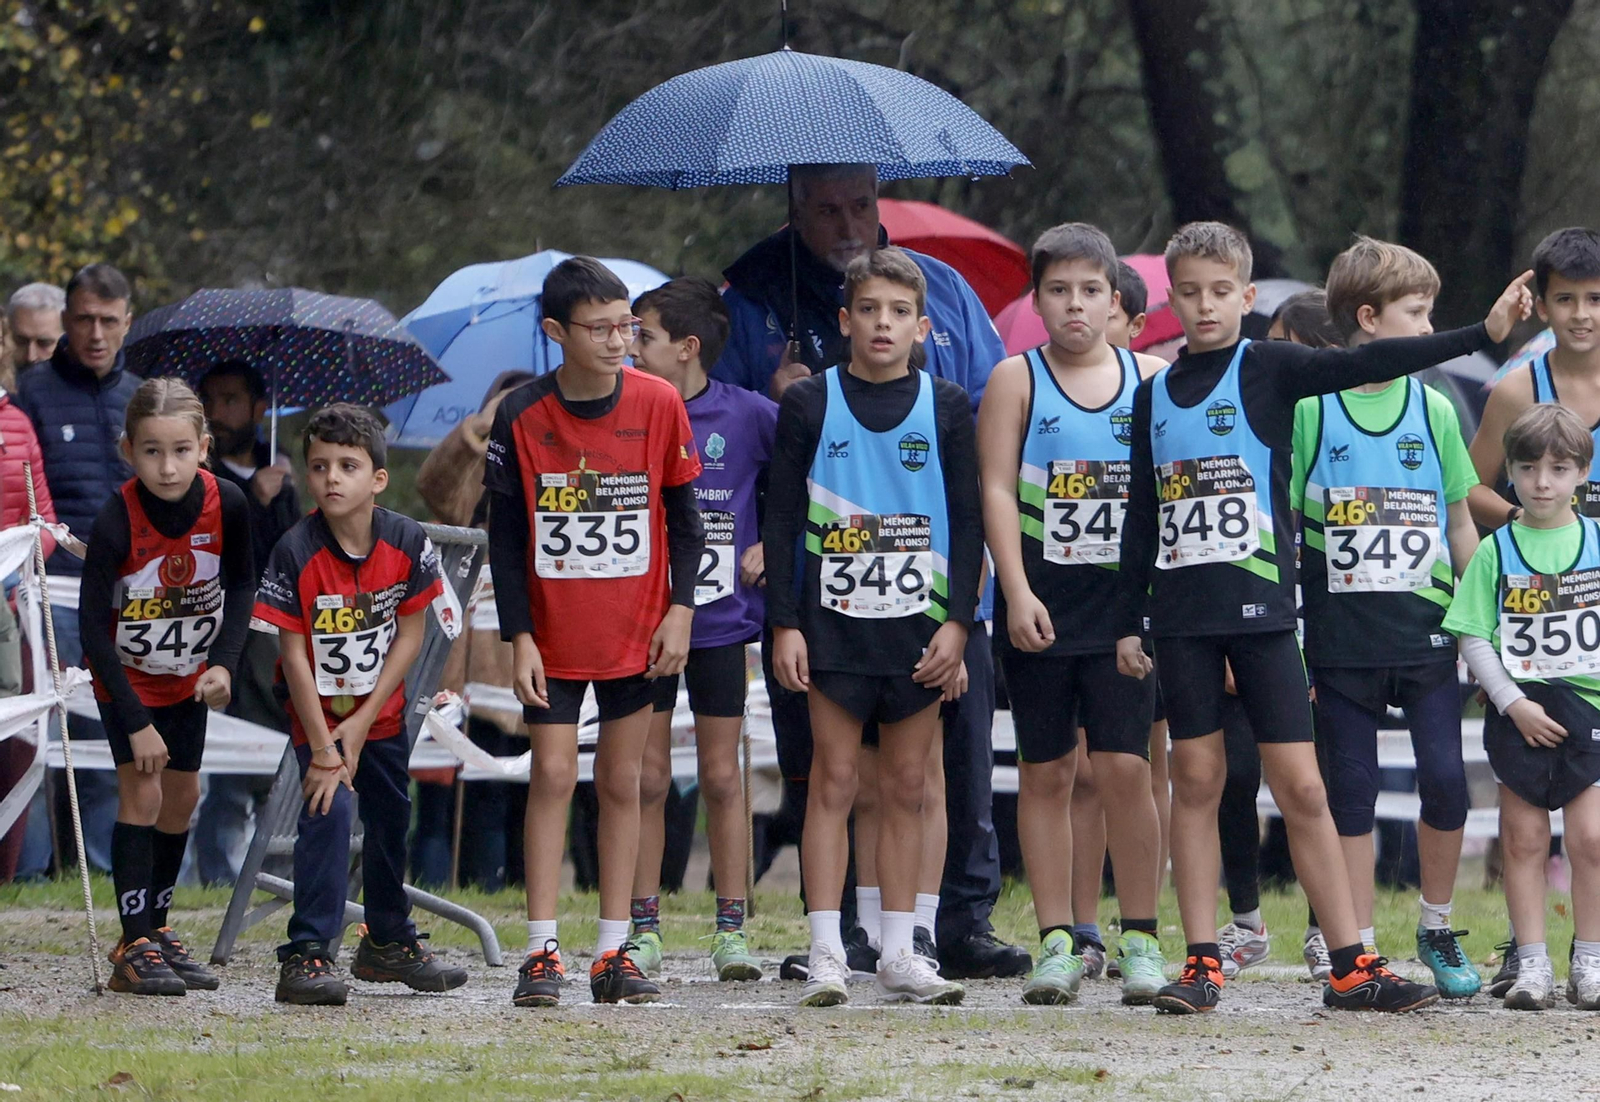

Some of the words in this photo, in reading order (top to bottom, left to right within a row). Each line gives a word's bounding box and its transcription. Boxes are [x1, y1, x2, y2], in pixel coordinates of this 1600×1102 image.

[1108, 464, 1131, 473] MEM
[1201, 458, 1240, 470] MEMOR
[600, 475, 648, 485] MEMORIAL
[1213, 478, 1253, 490] ALONO
[595, 485, 649, 496] BELARMINO
[611, 496, 647, 506] ALONSO
[1383, 502, 1437, 512] BELARMINO
[1050, 502, 1127, 542] 34
[1161, 497, 1249, 547] 348
[1399, 513, 1436, 522] ALONSO
[541, 514, 640, 556] 335
[705, 532, 732, 540] ONSO
[879, 527, 931, 537] BELARMINO
[894, 538, 929, 547] ALONSO
[1330, 529, 1431, 570] 349
[825, 555, 925, 596] 346
[120, 616, 216, 657] 342
[1506, 610, 1600, 657] 350
